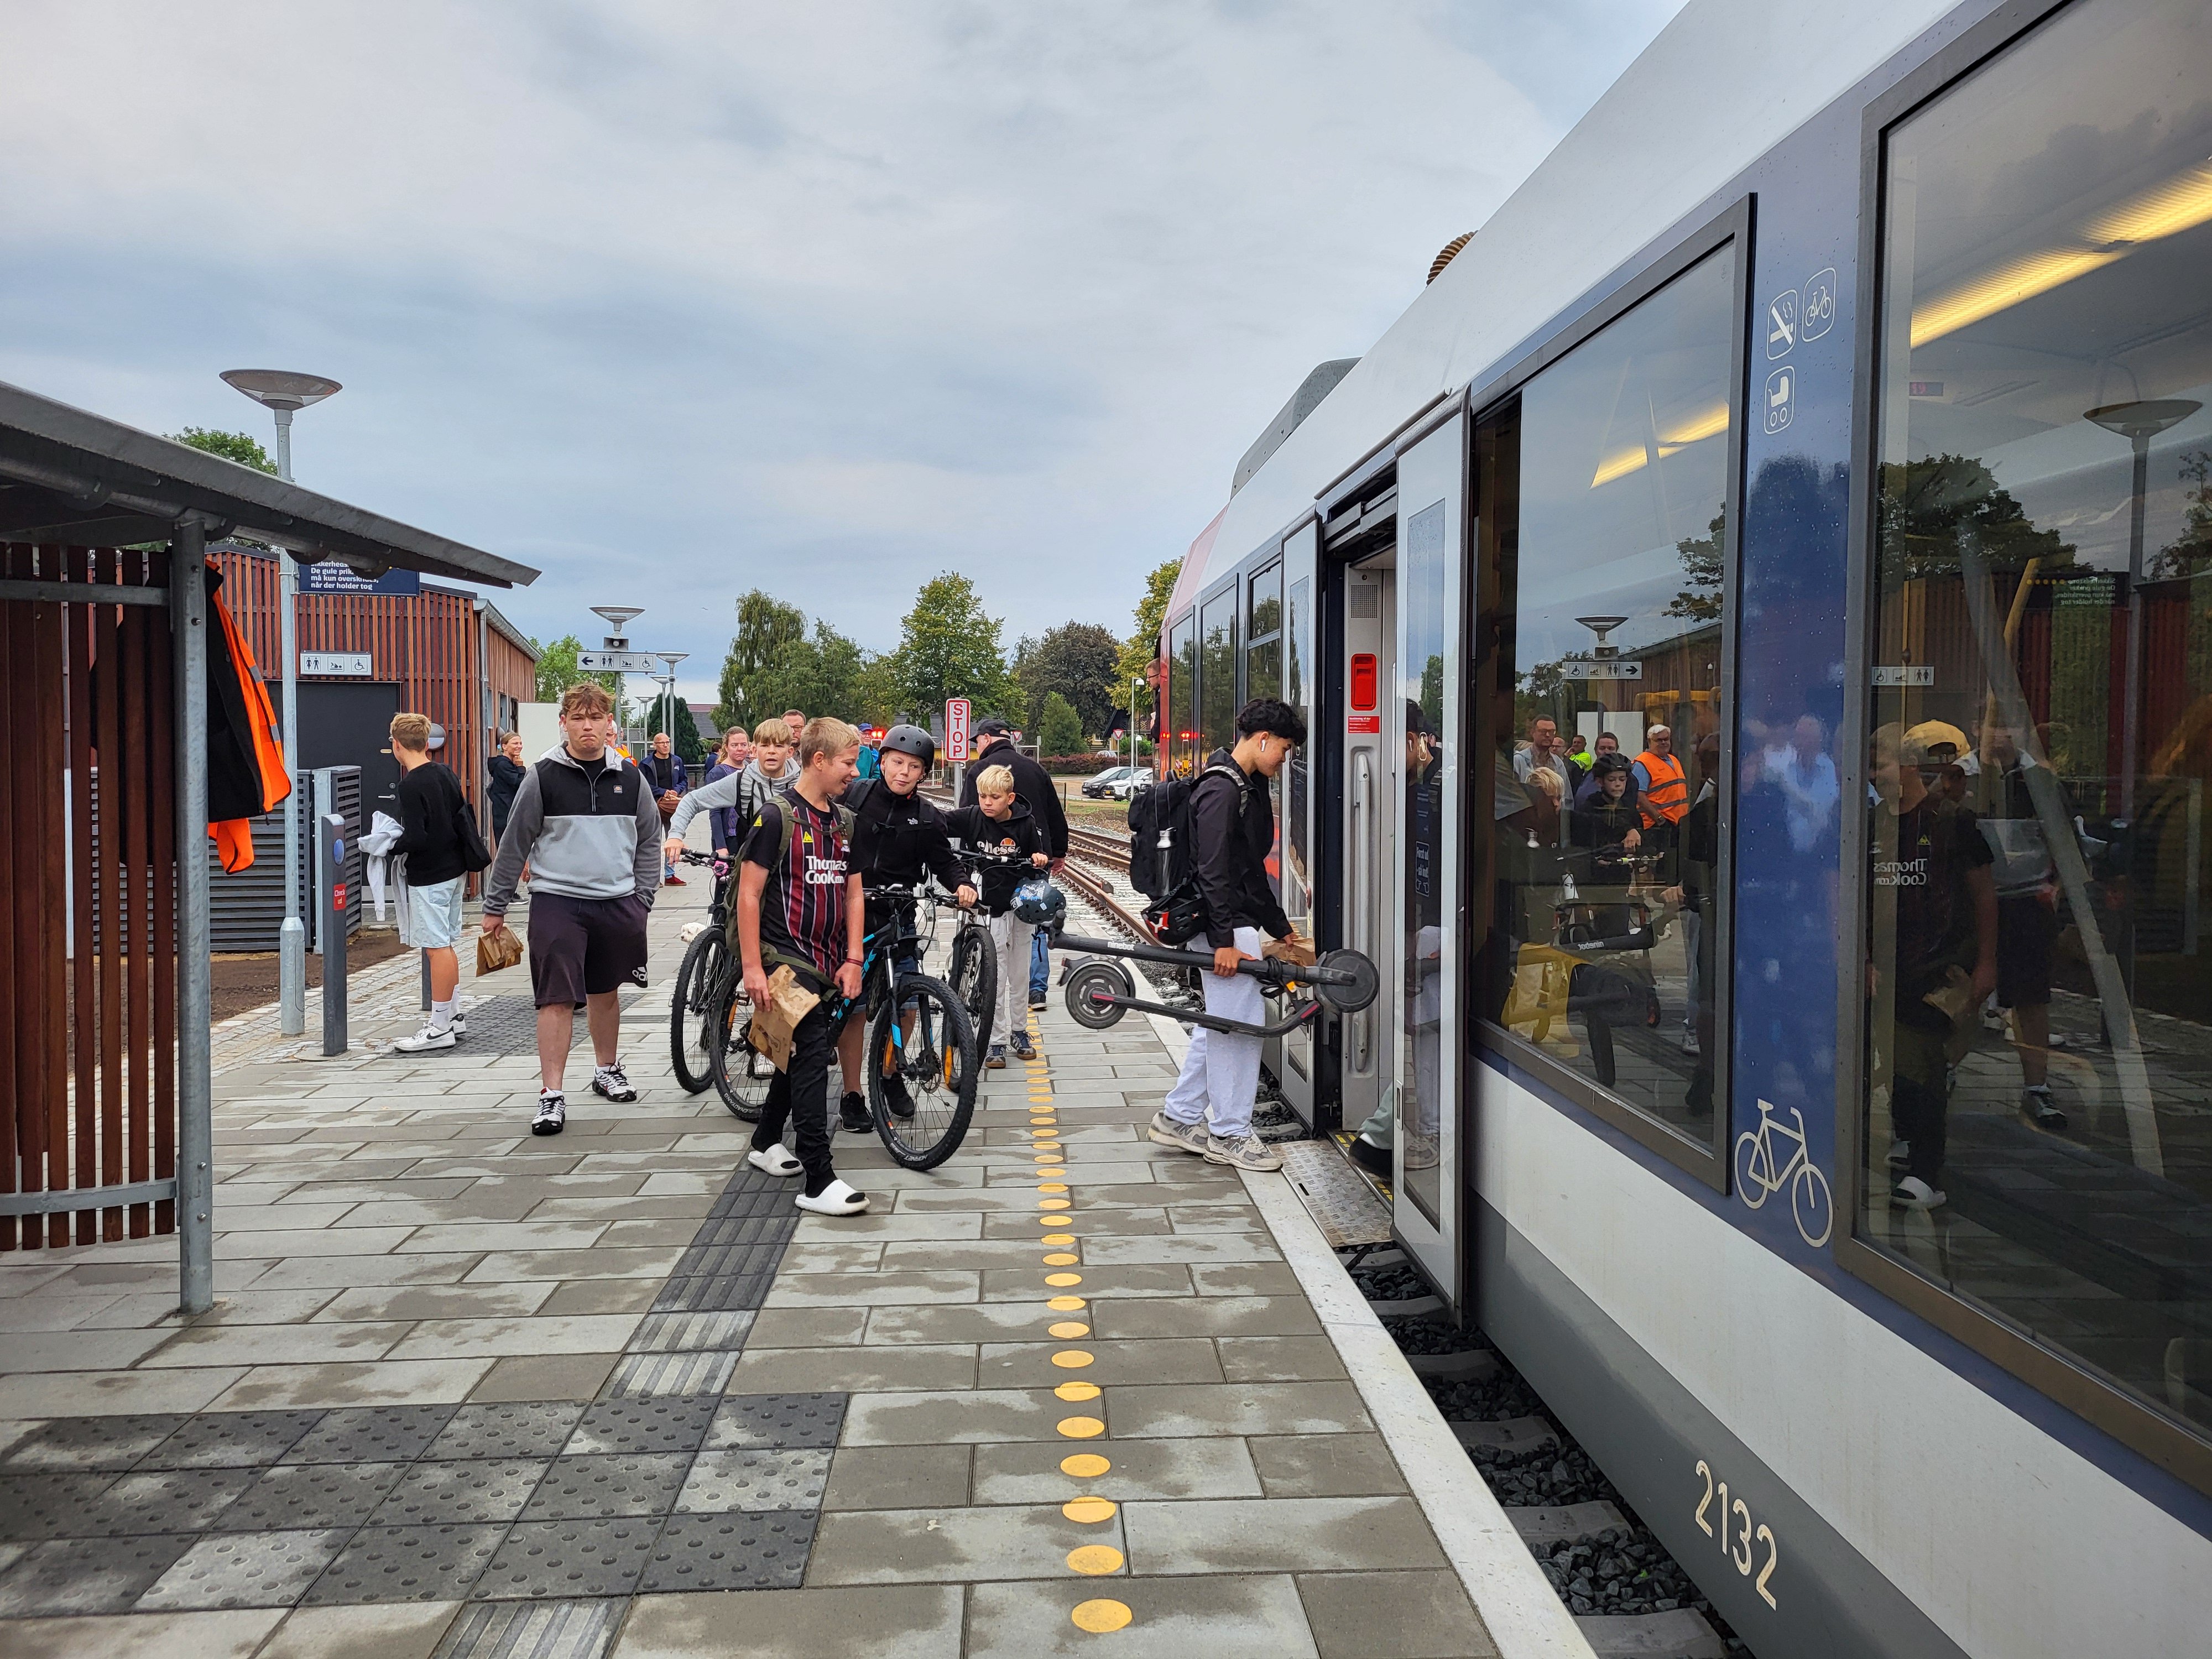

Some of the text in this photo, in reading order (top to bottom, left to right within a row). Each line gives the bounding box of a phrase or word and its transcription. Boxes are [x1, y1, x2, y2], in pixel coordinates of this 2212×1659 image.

[952, 703, 963, 757] STOP
[805, 855, 847, 871] Thomas
[1695, 1460, 1776, 1611] 2132
